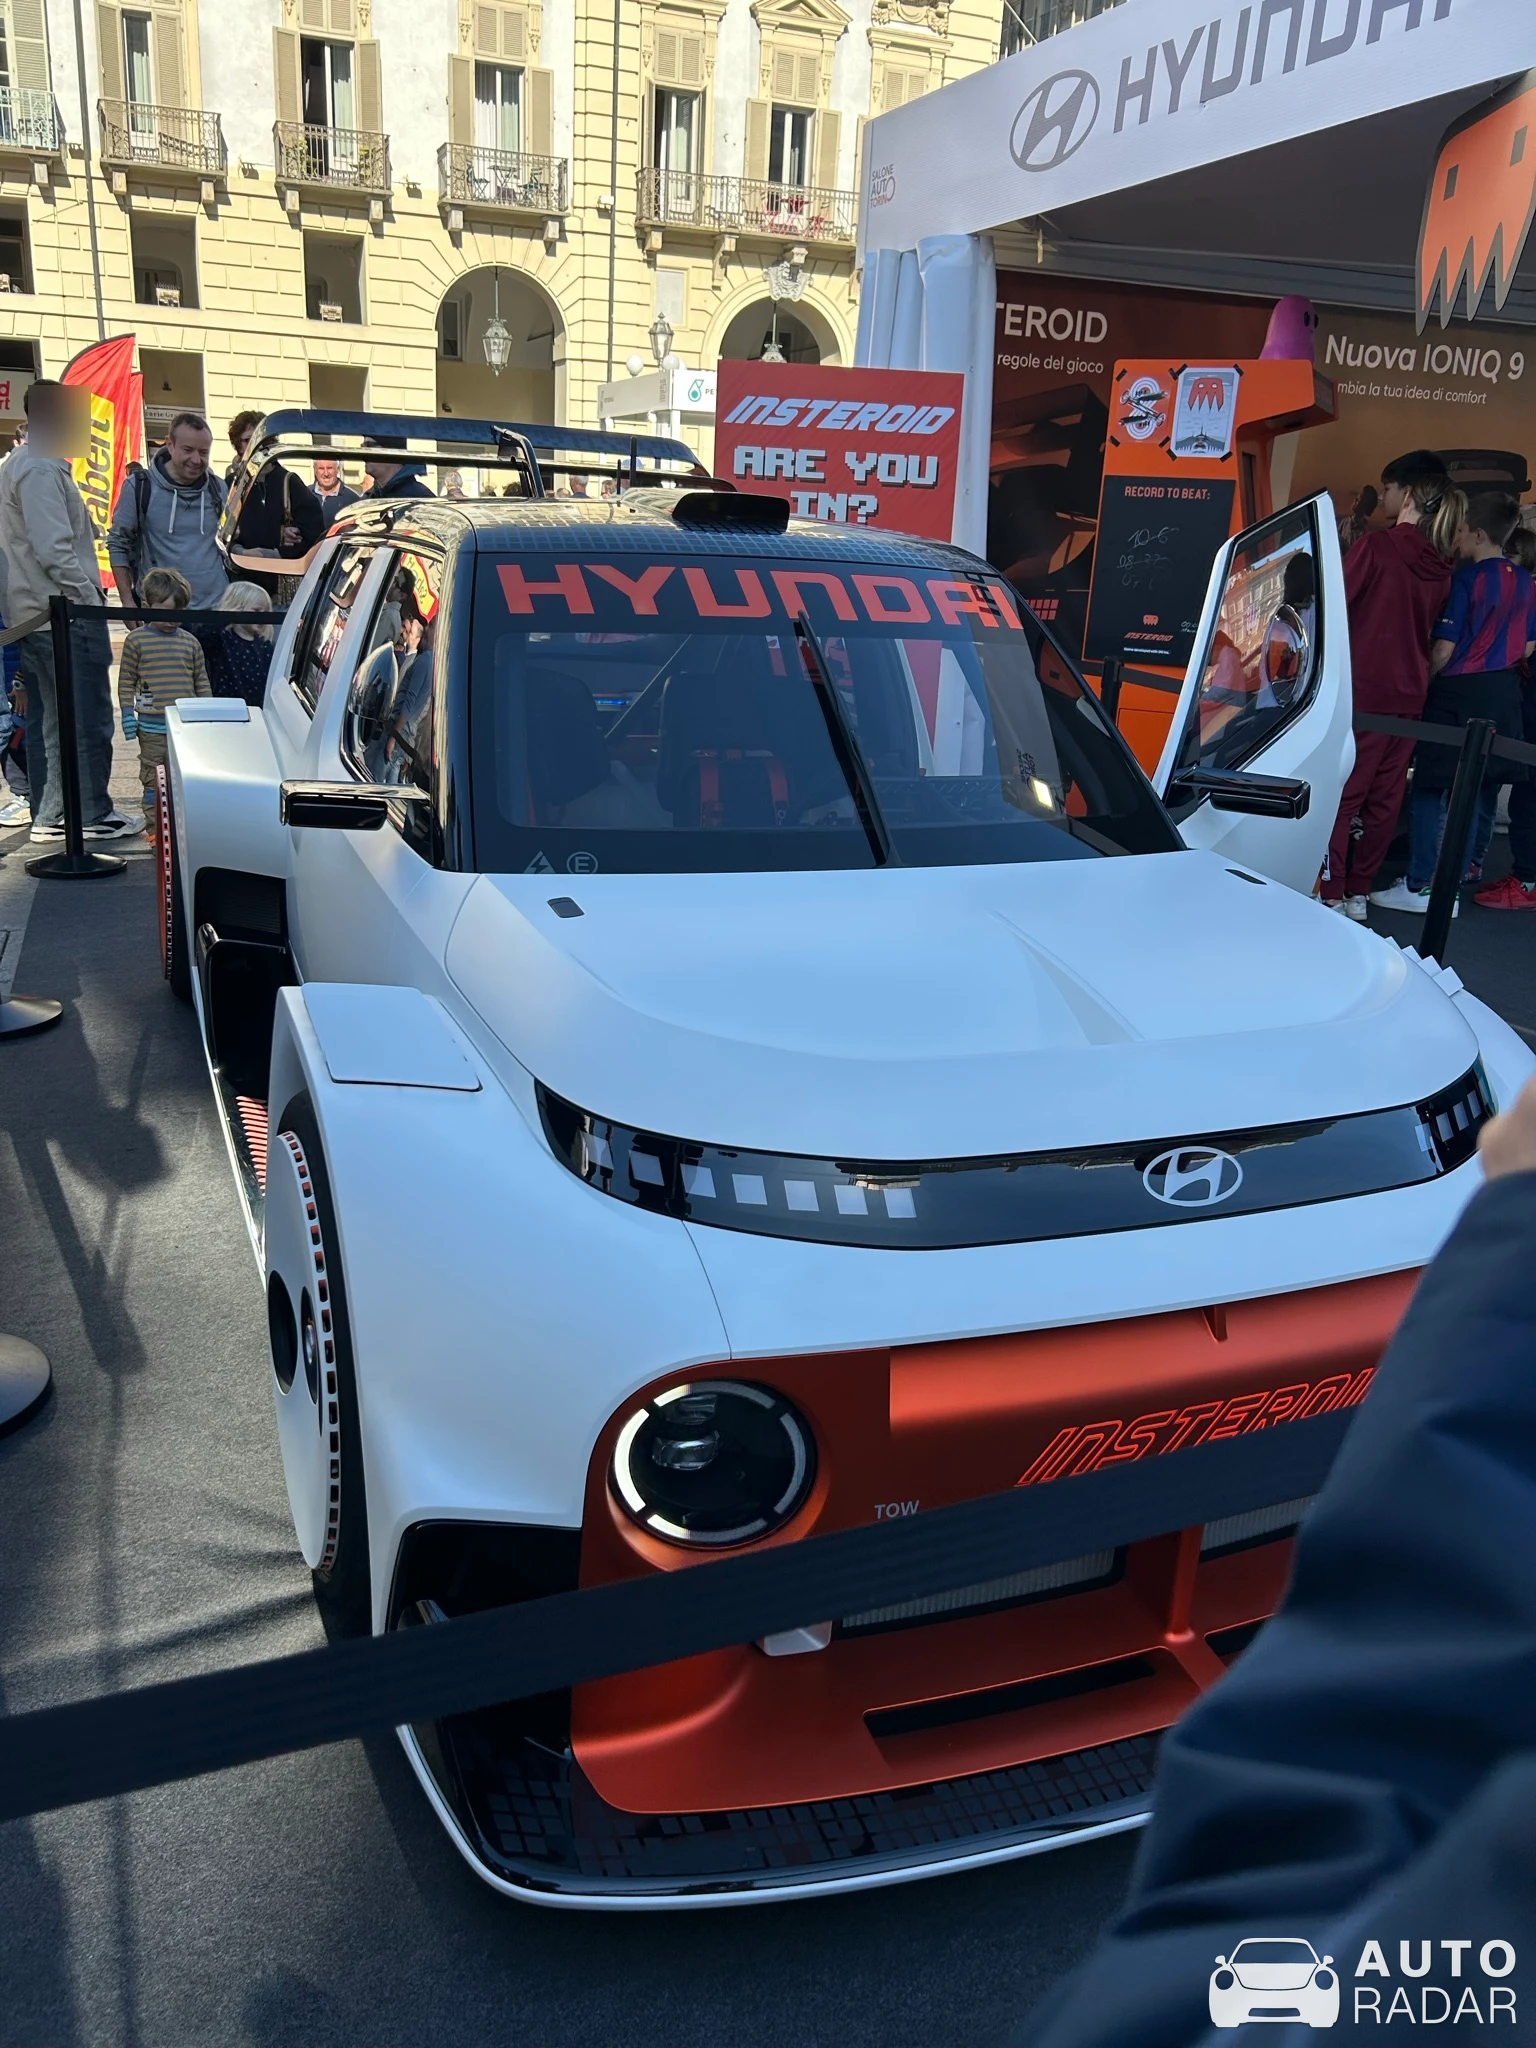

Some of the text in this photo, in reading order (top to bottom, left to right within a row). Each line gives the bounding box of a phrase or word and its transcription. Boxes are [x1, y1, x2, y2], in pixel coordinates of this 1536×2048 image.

[1113, 0, 1452, 134] HYUNDA
[997, 353, 1104, 375] regole del gioco
[1325, 334, 1525, 384] Nuova IONIQ 9
[1368, 382, 1380, 396] la
[1384, 384, 1403, 398] tua
[1404, 385, 1430, 400] idea
[1432, 388, 1443, 401] di
[1445, 390, 1488, 405] comfort
[722, 395, 956, 435] INSTEROID
[733, 445, 939, 489] ARE YOU
[790, 491, 880, 525] IN?
[1124, 485, 1211, 500] RECORD TO BEAT:
[496, 564, 1024, 630] HYUNDAI
[1014, 1366, 1381, 1488] INSTEROI
[874, 1500, 920, 1520] TOW
